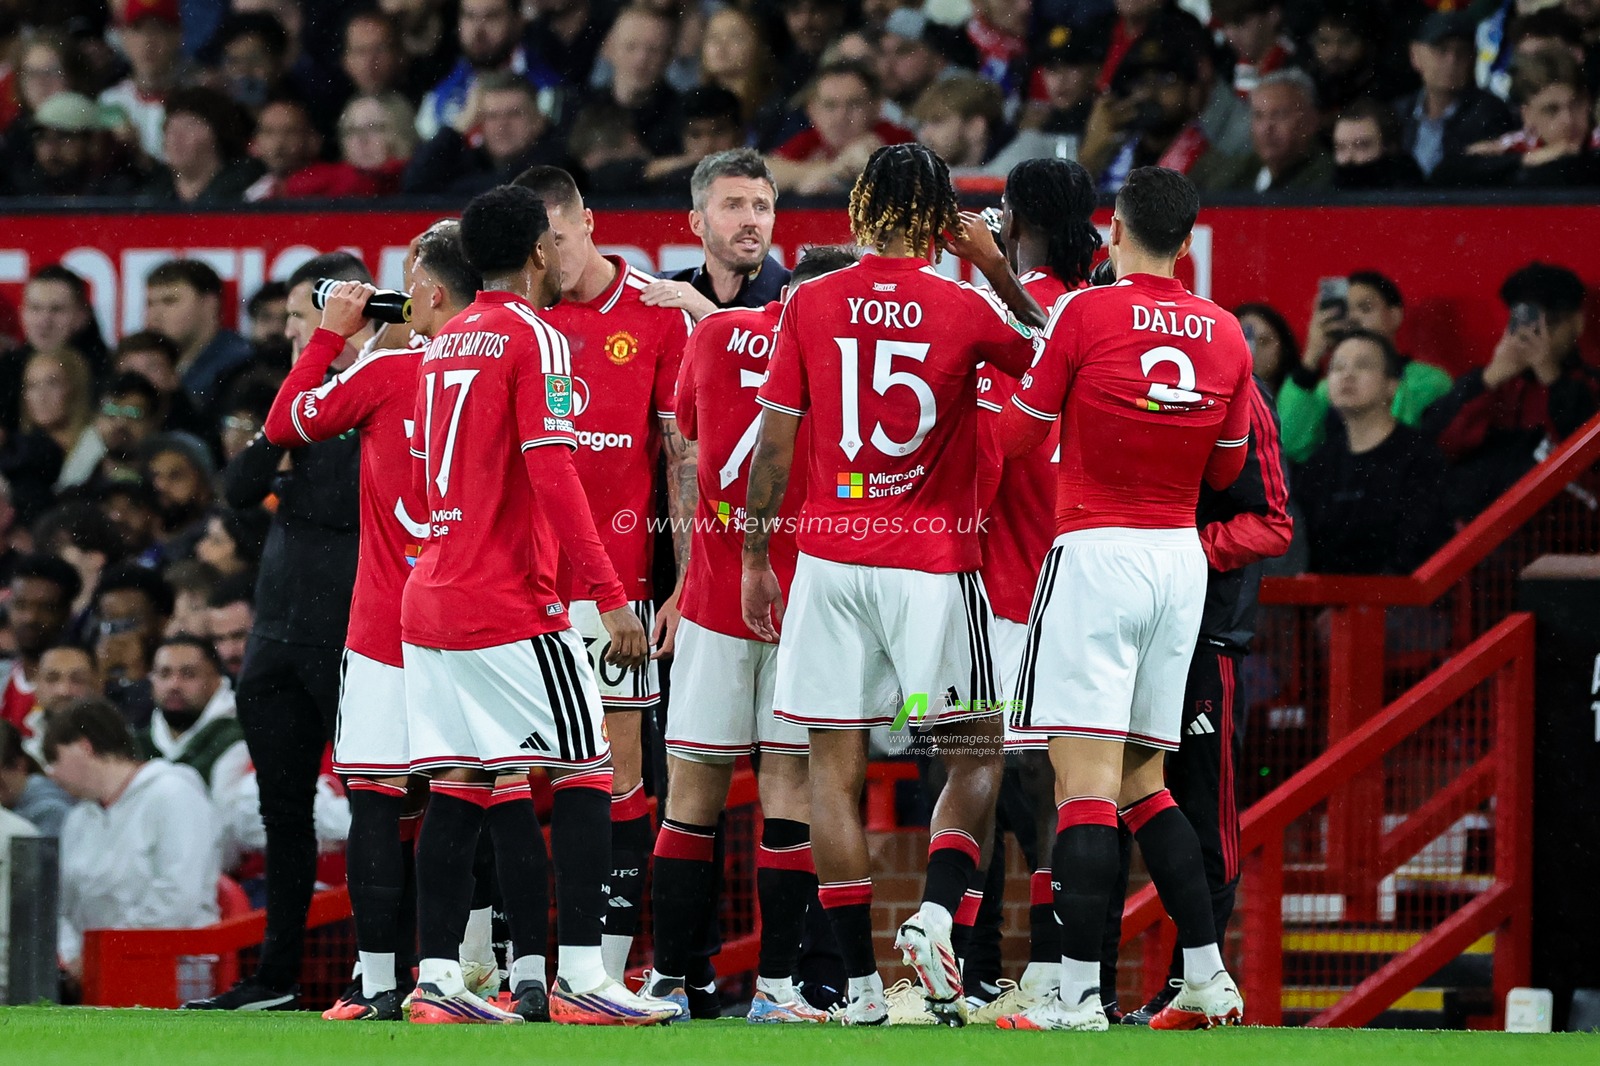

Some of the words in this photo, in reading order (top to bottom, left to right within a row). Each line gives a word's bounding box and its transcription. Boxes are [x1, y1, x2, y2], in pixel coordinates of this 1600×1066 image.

[847, 297, 923, 329] YORO
[1131, 304, 1216, 343] DALOT
[457, 331, 510, 359] SANTOS
[1140, 345, 1203, 403] 2
[833, 337, 937, 462] 15
[425, 369, 481, 499] 17
[868, 465, 925, 486] Microsoft
[868, 482, 913, 499] Surface
